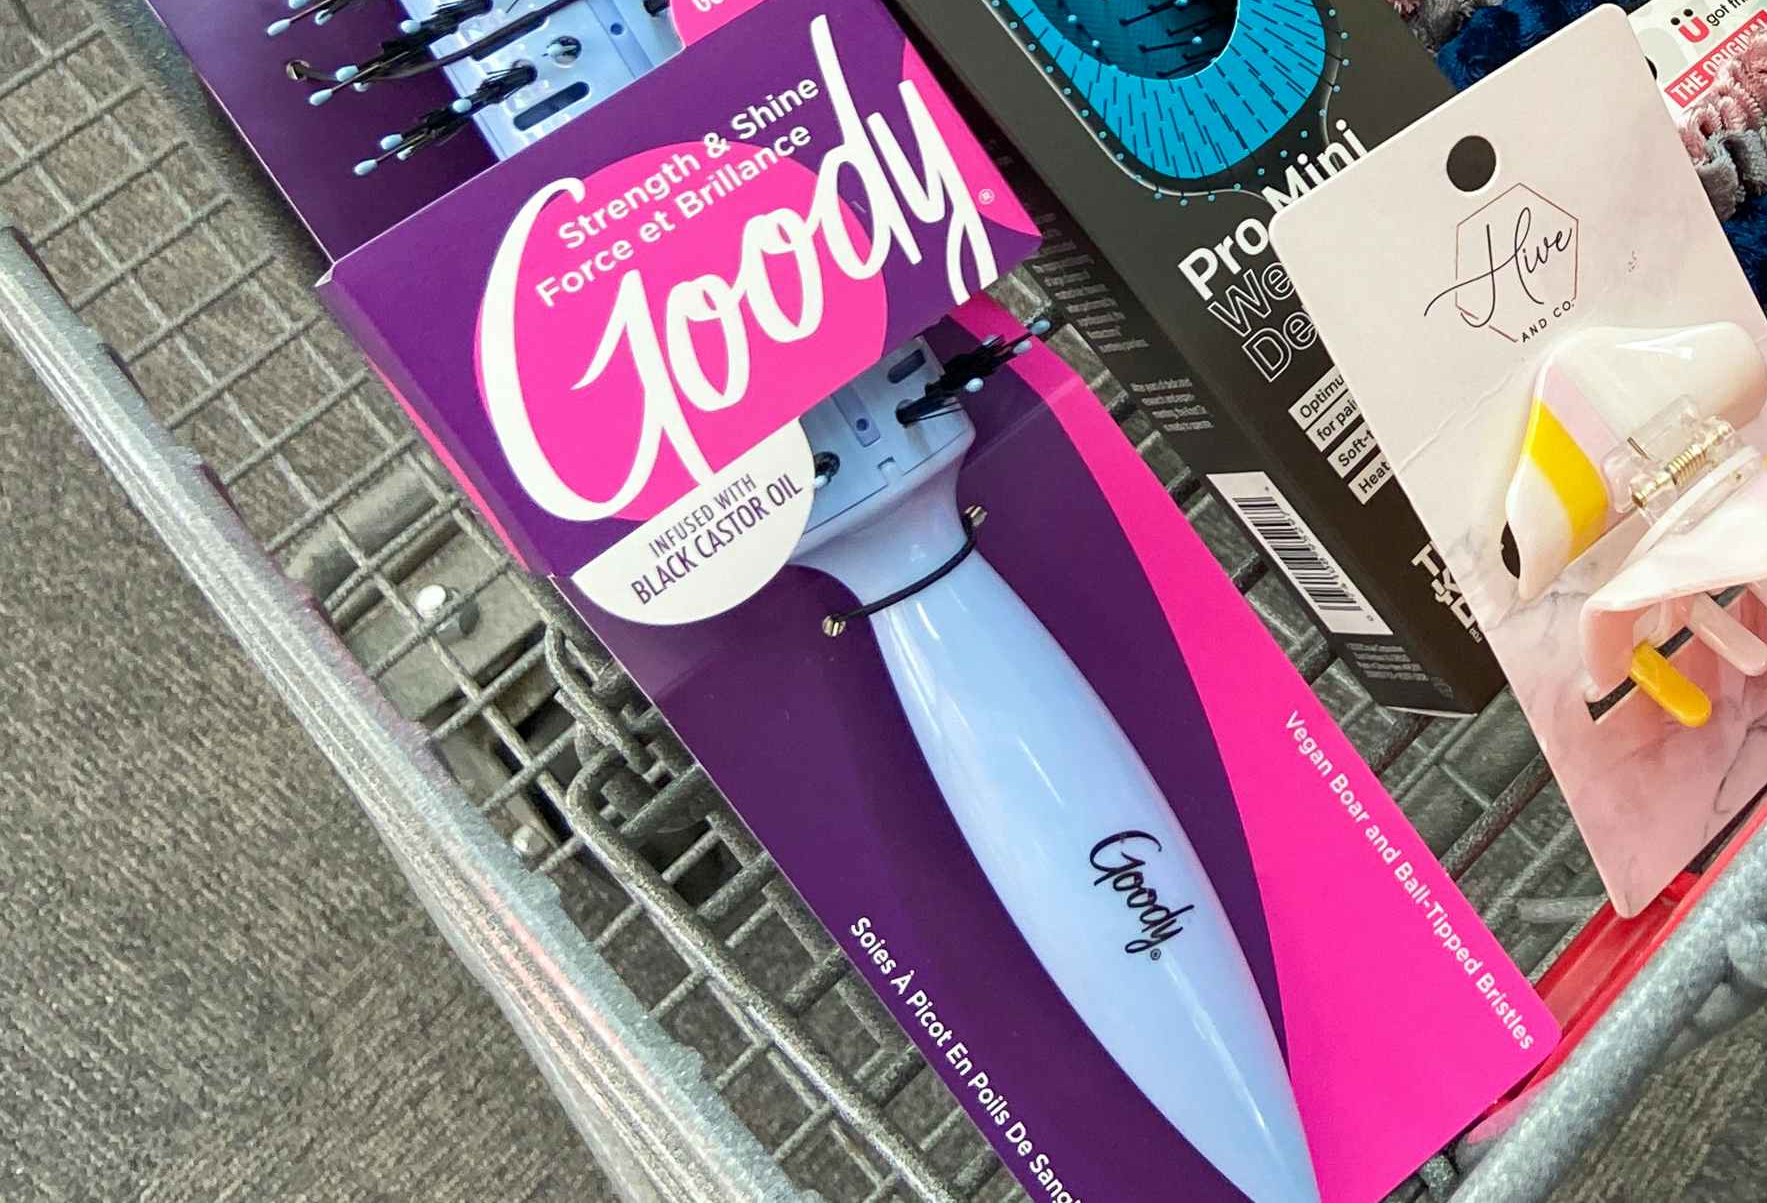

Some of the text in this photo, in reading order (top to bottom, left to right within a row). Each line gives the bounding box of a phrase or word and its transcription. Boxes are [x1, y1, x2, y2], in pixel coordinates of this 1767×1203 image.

[1706, 3, 1730, 27] got
[1670, 69, 1709, 101] THE
[534, 122, 814, 309] Force et Brillance
[556, 74, 821, 252] Strength & Shine
[1177, 214, 1270, 302] Pro
[1262, 118, 1369, 213] Mini
[480, 13, 1000, 522] Goody
[1206, 259, 1296, 341] We
[1423, 206, 1574, 329] Hive
[1521, 317, 1549, 344] AND
[1299, 373, 1346, 420] Optimu
[1315, 421, 1337, 442] for
[648, 472, 759, 557] INFUSED WITH
[1357, 460, 1391, 495] Heat
[630, 473, 805, 607] BLACK CASTOR OIL
[1088, 828, 1196, 954] Goody
[1283, 709, 1536, 1053] Vegan Boar and Ball-Tipped Bristles
[849, 916, 896, 977] Soies
[888, 967, 918, 998] À
[905, 988, 956, 1051] Picot
[944, 1041, 973, 1077] En
[968, 1073, 1010, 1132] Poils
[1005, 1120, 1034, 1157] De
